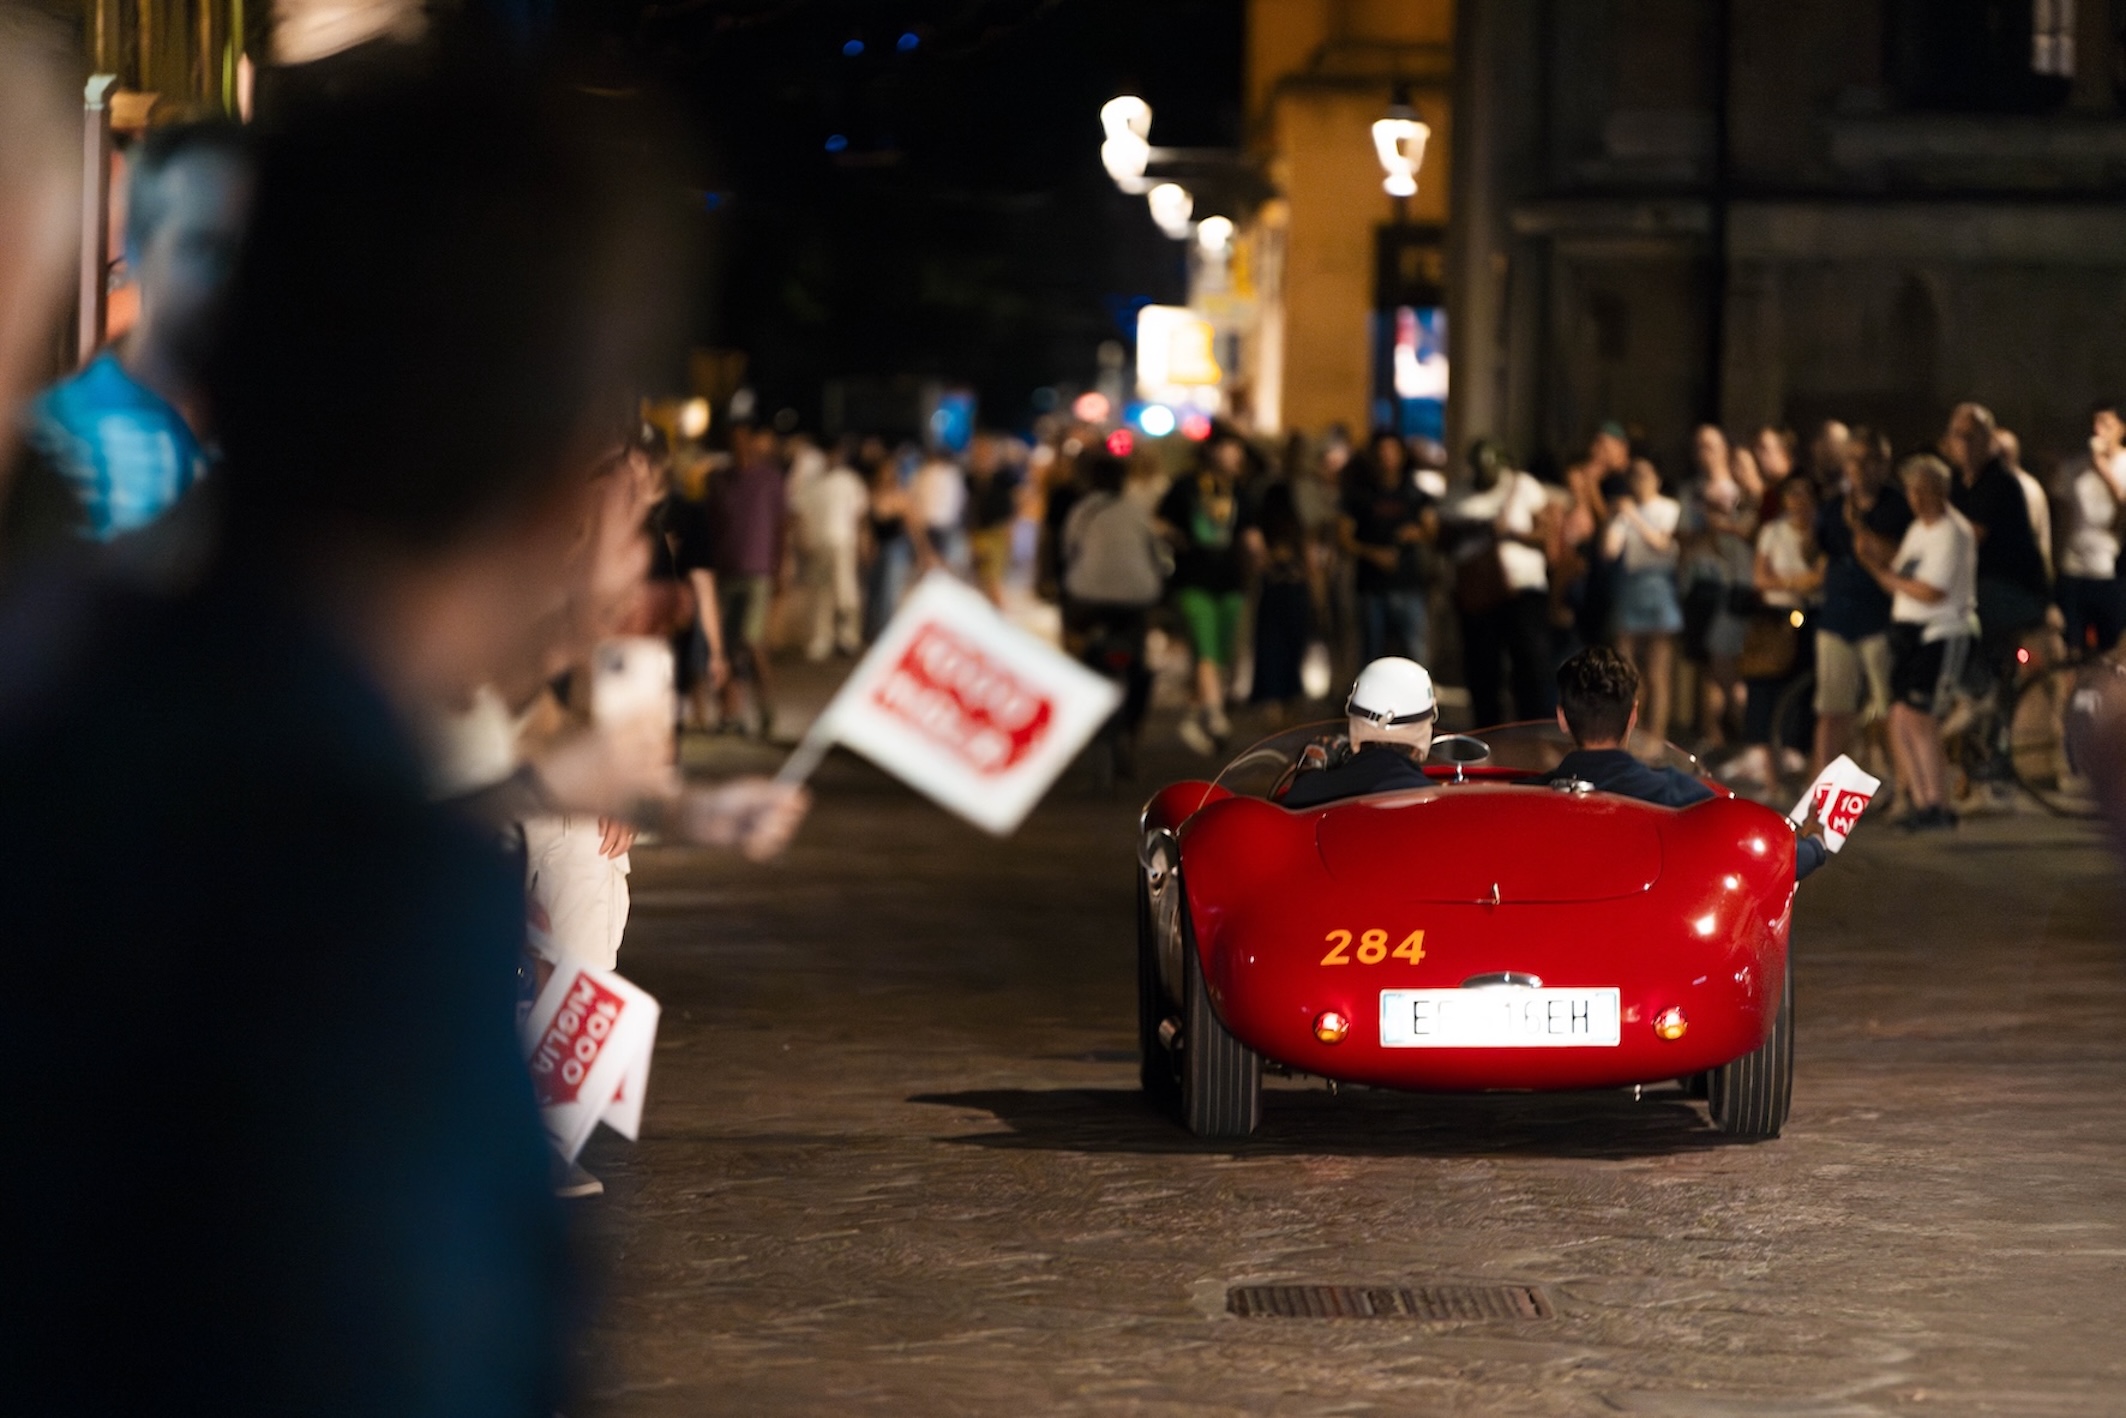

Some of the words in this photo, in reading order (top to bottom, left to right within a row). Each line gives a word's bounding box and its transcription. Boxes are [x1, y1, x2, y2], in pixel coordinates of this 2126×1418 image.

[1841, 795, 1869, 814] 10
[1320, 928, 1427, 966] 284
[535, 977, 597, 1074] MIGLIA
[562, 1000, 618, 1085] 1000
